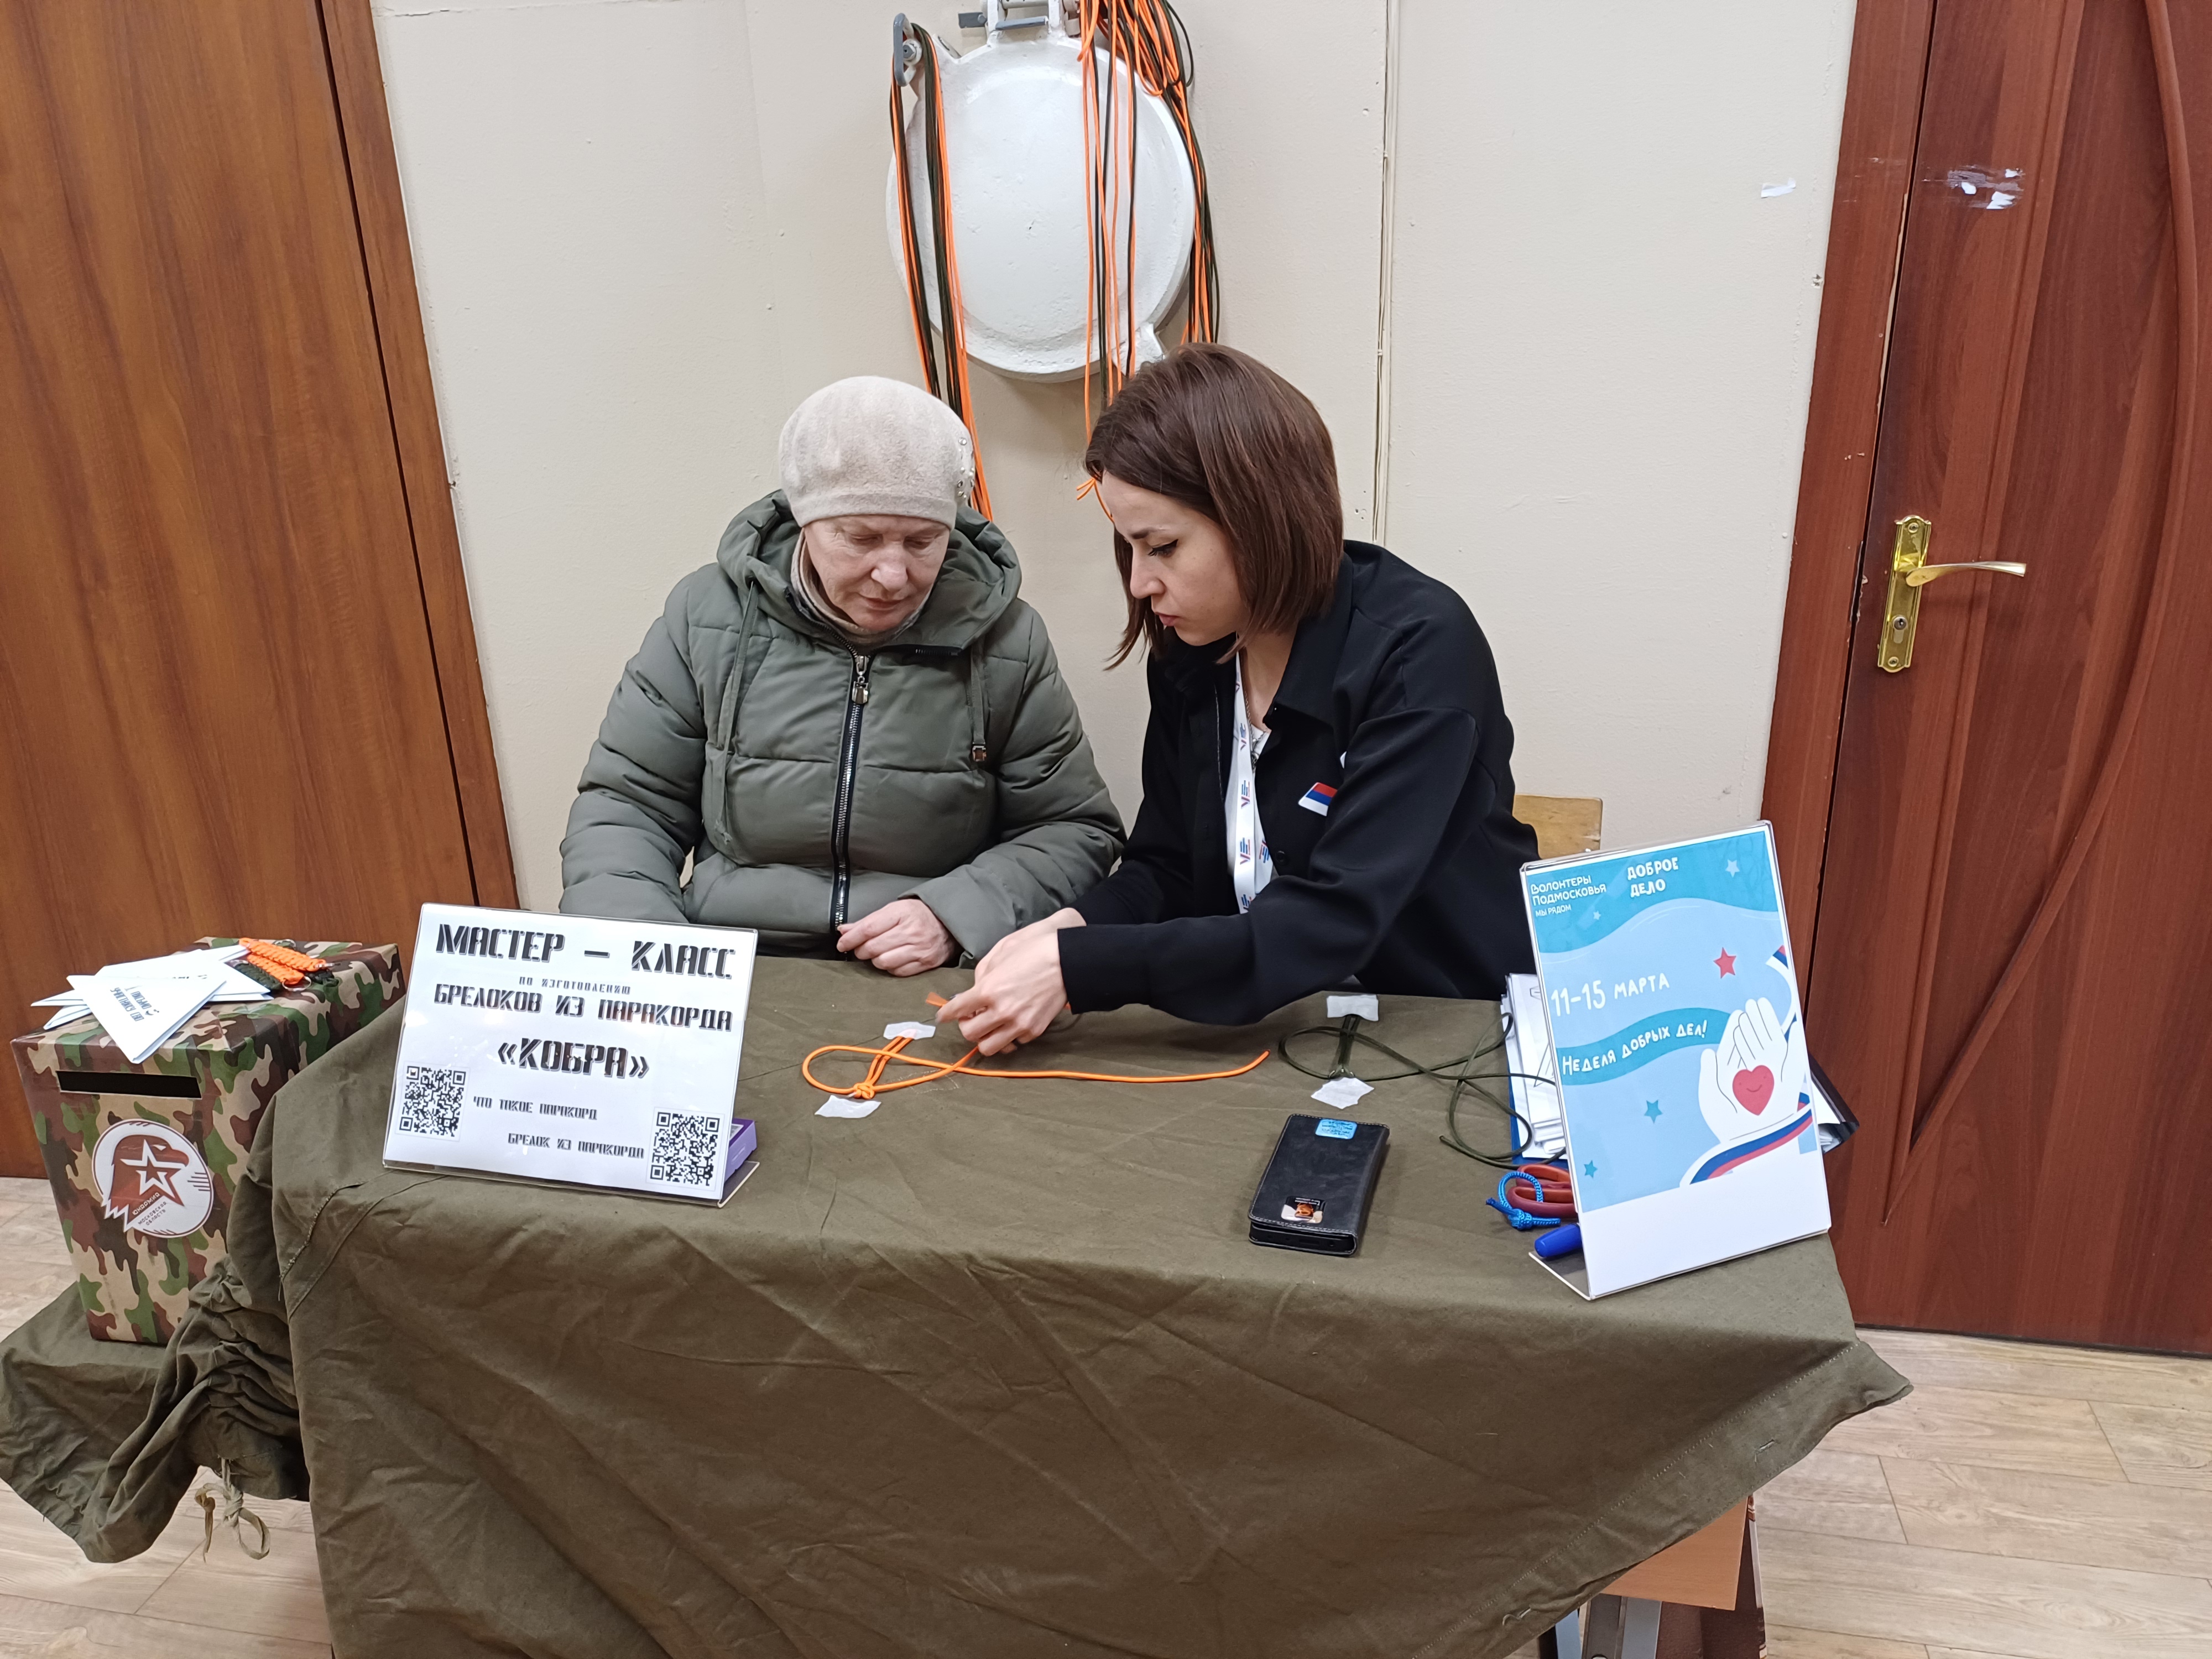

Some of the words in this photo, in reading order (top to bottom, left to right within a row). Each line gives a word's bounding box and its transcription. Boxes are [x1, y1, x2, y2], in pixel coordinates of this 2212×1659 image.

[1627, 857, 1678, 880] ДОБРОЕ
[1630, 879, 1666, 898] ДЕЛО
[1535, 909, 1547, 917] МЫ
[1548, 904, 1571, 915] РЯДОМ
[436, 924, 566, 963] МАСТЕР
[632, 941, 735, 979] КЛАСС
[519, 977, 533, 985] ПО
[541, 978, 630, 995] ИЗГОТОВЛЕНИЮ
[1551, 980, 1605, 1016] 11-15
[1614, 973, 1670, 999] МАРТА
[434, 984, 543, 1013] БРЕЛОКОВ
[555, 995, 585, 1017] ИЗ
[598, 999, 733, 1032] ПАРАКОРДА
[498, 1038, 649, 1078] «КОБРА»
[473, 1096, 492, 1108] ЧТО
[499, 1099, 533, 1113] ТАКОЕ
[540, 1103, 597, 1120] ПАРАКОРД
[508, 1133, 550, 1148] БРЕЛОК
[557, 1139, 571, 1150] ИЗ
[578, 1141, 644, 1159] ПАРАКОРДА
[132, 1192, 160, 1215] ЮНАРМИЯ
[138, 1201, 166, 1225] МОСКОВСКАЯ
[145, 1209, 166, 1225] ОБЛАСТЬ
